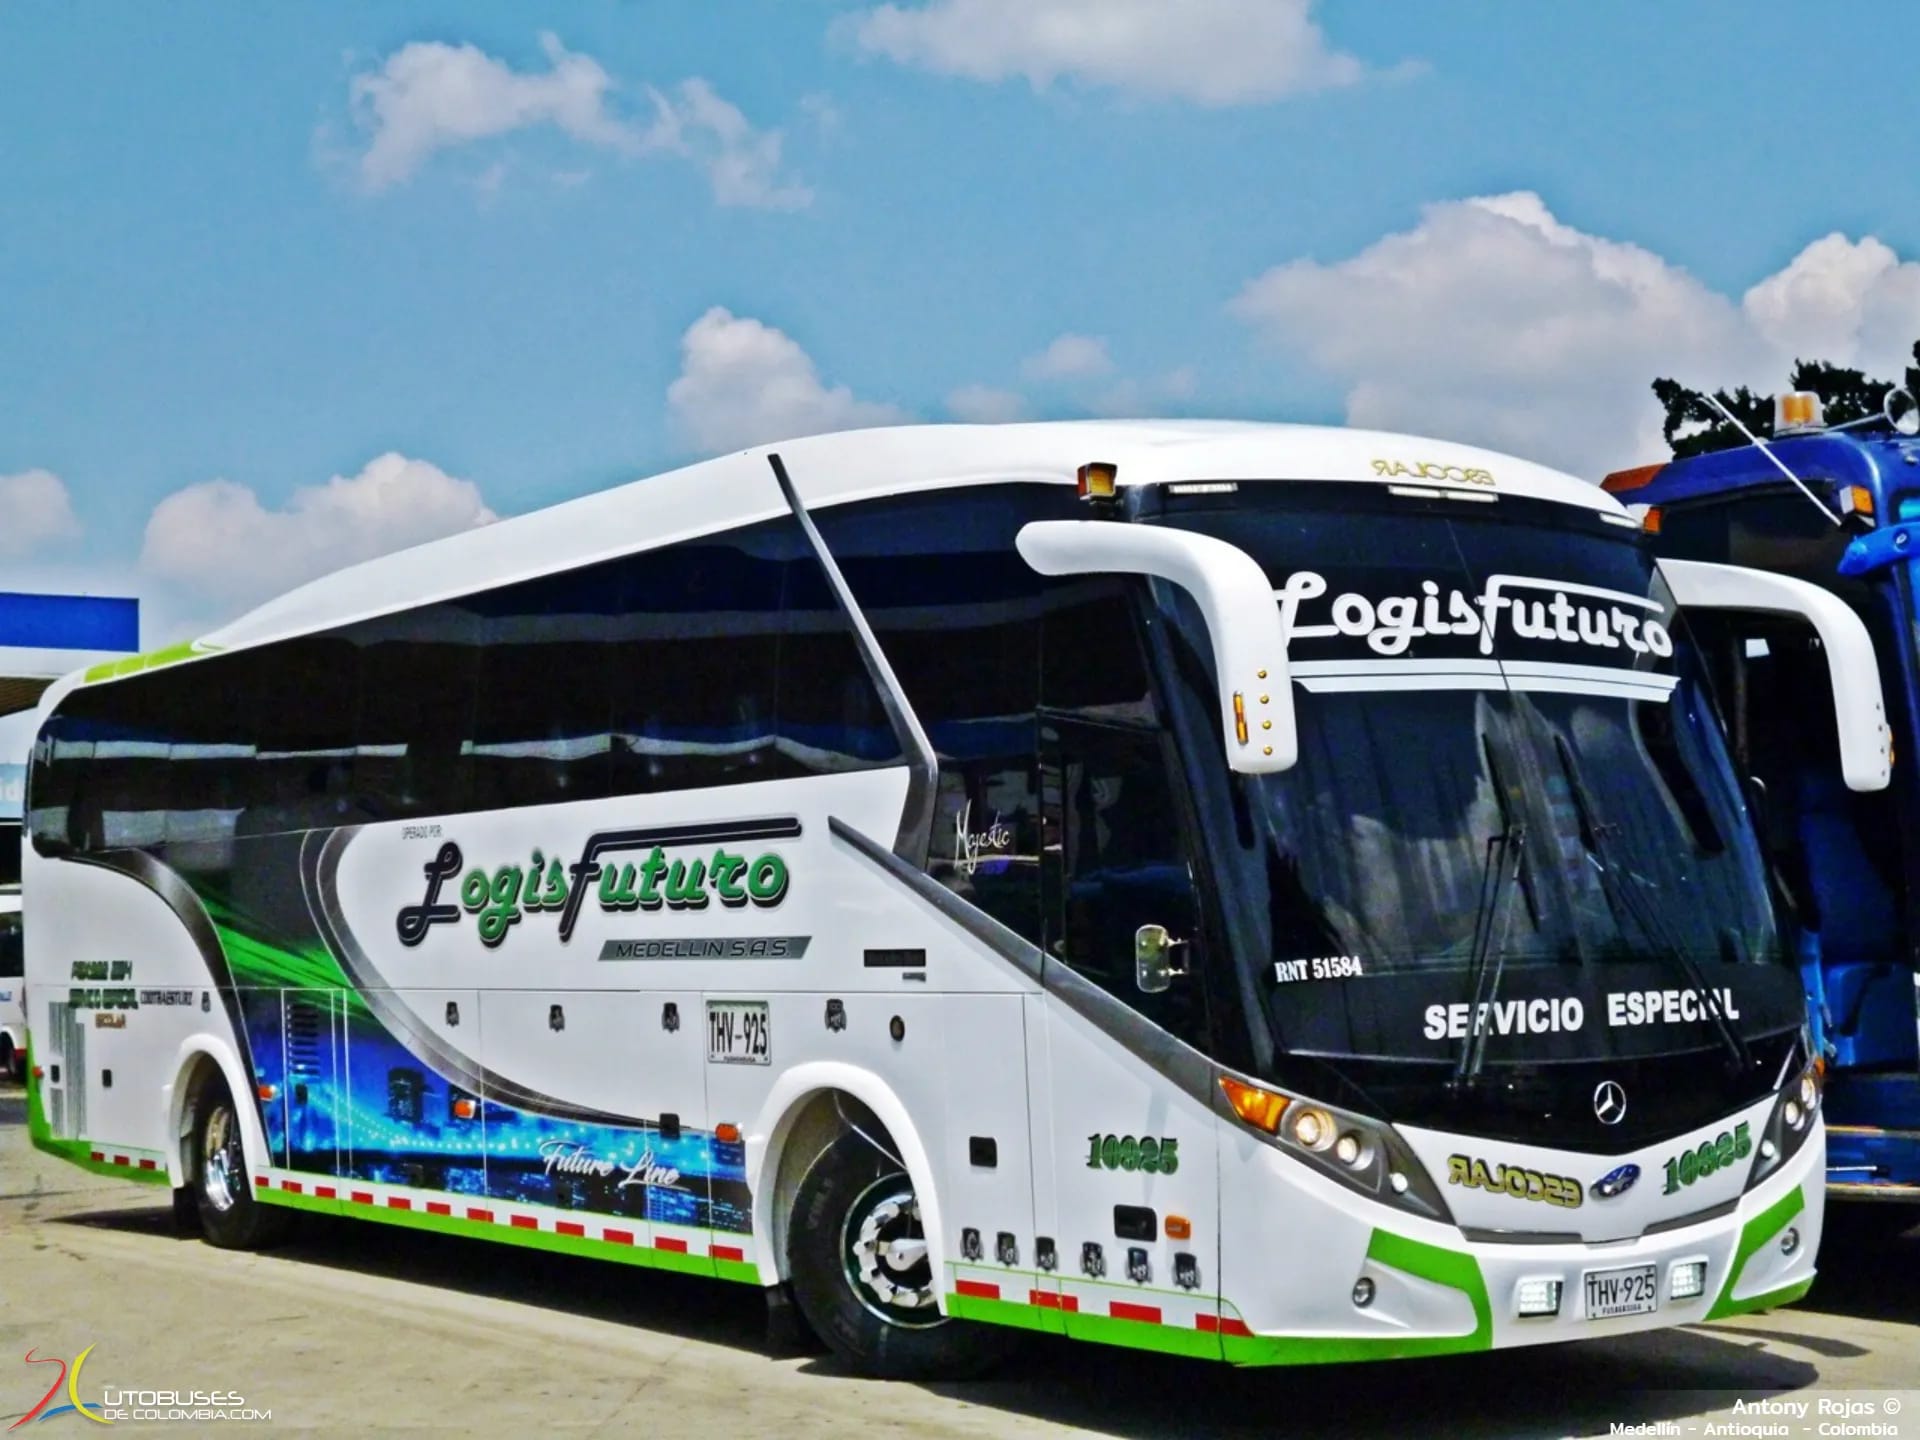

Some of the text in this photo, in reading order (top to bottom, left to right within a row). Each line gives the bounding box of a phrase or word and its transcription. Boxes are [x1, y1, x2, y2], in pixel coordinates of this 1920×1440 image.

[615, 940, 791, 958] MEDELLIN S.A.S.
[1274, 955, 1363, 983] RNT 51584
[708, 1011, 768, 1056] THV-925
[1423, 997, 1585, 1041] SERVICIO
[1085, 1132, 1179, 1176] 10825
[1661, 1120, 1753, 1197] 10825
